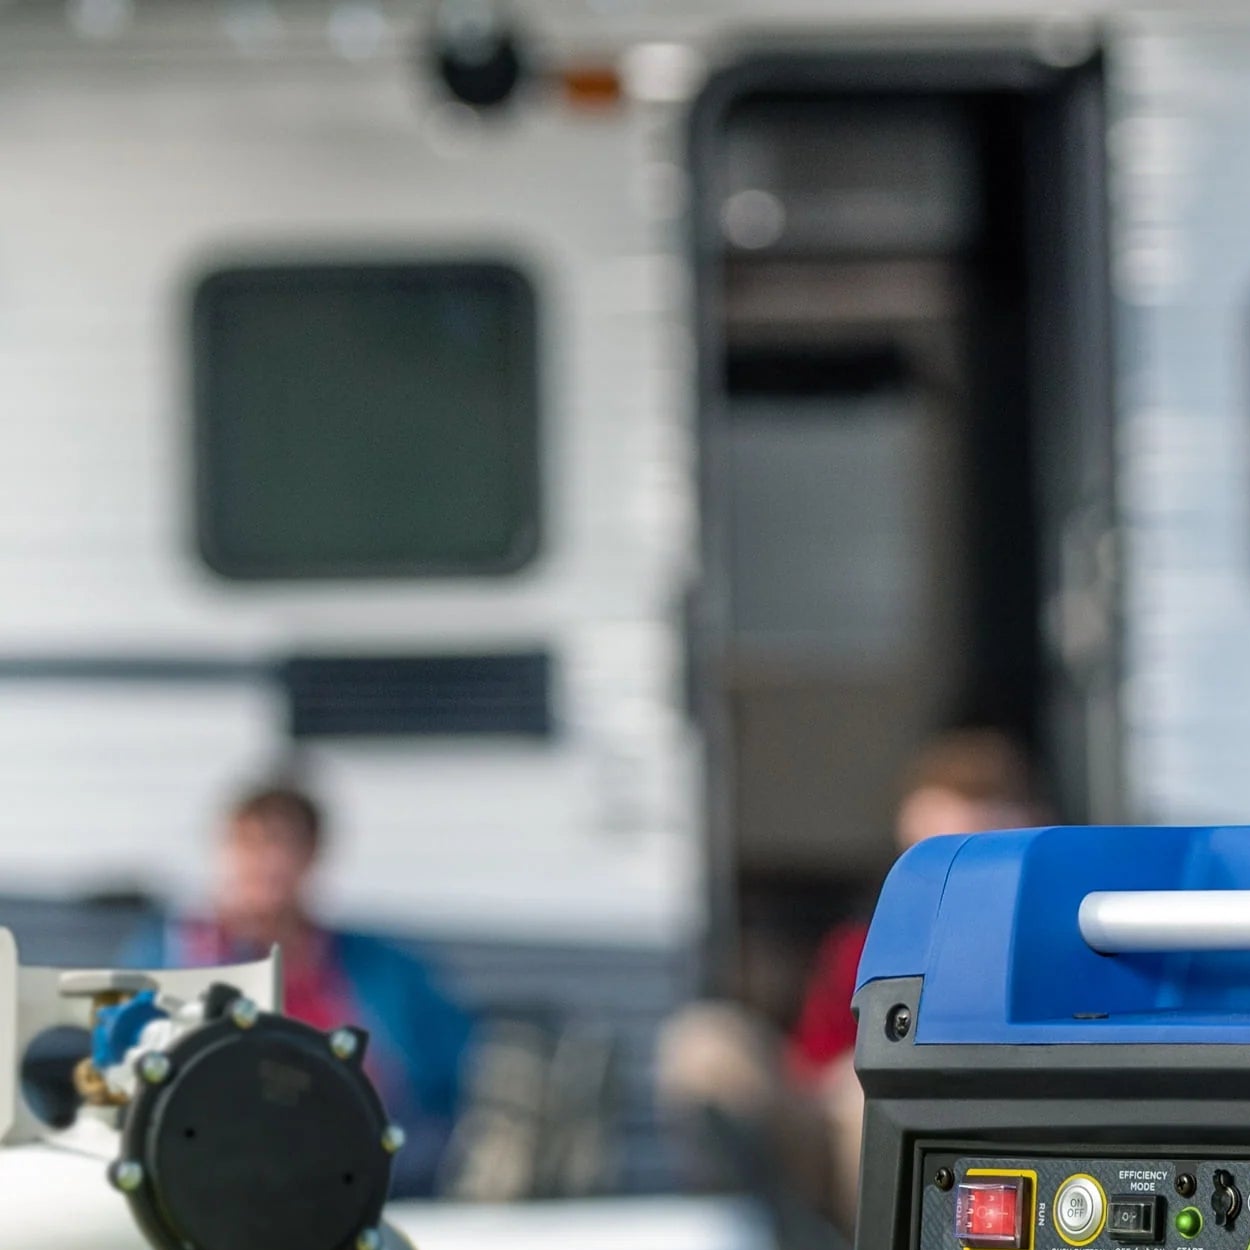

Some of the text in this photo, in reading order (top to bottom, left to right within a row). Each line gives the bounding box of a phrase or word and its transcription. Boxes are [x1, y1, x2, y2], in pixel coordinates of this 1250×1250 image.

[1119, 1170, 1168, 1180] EFFICIENCY
[1130, 1182, 1156, 1191] MODE
[1070, 1199, 1083, 1208] ON
[1038, 1202, 1046, 1226] RUN
[1067, 1208, 1085, 1217] OFF
